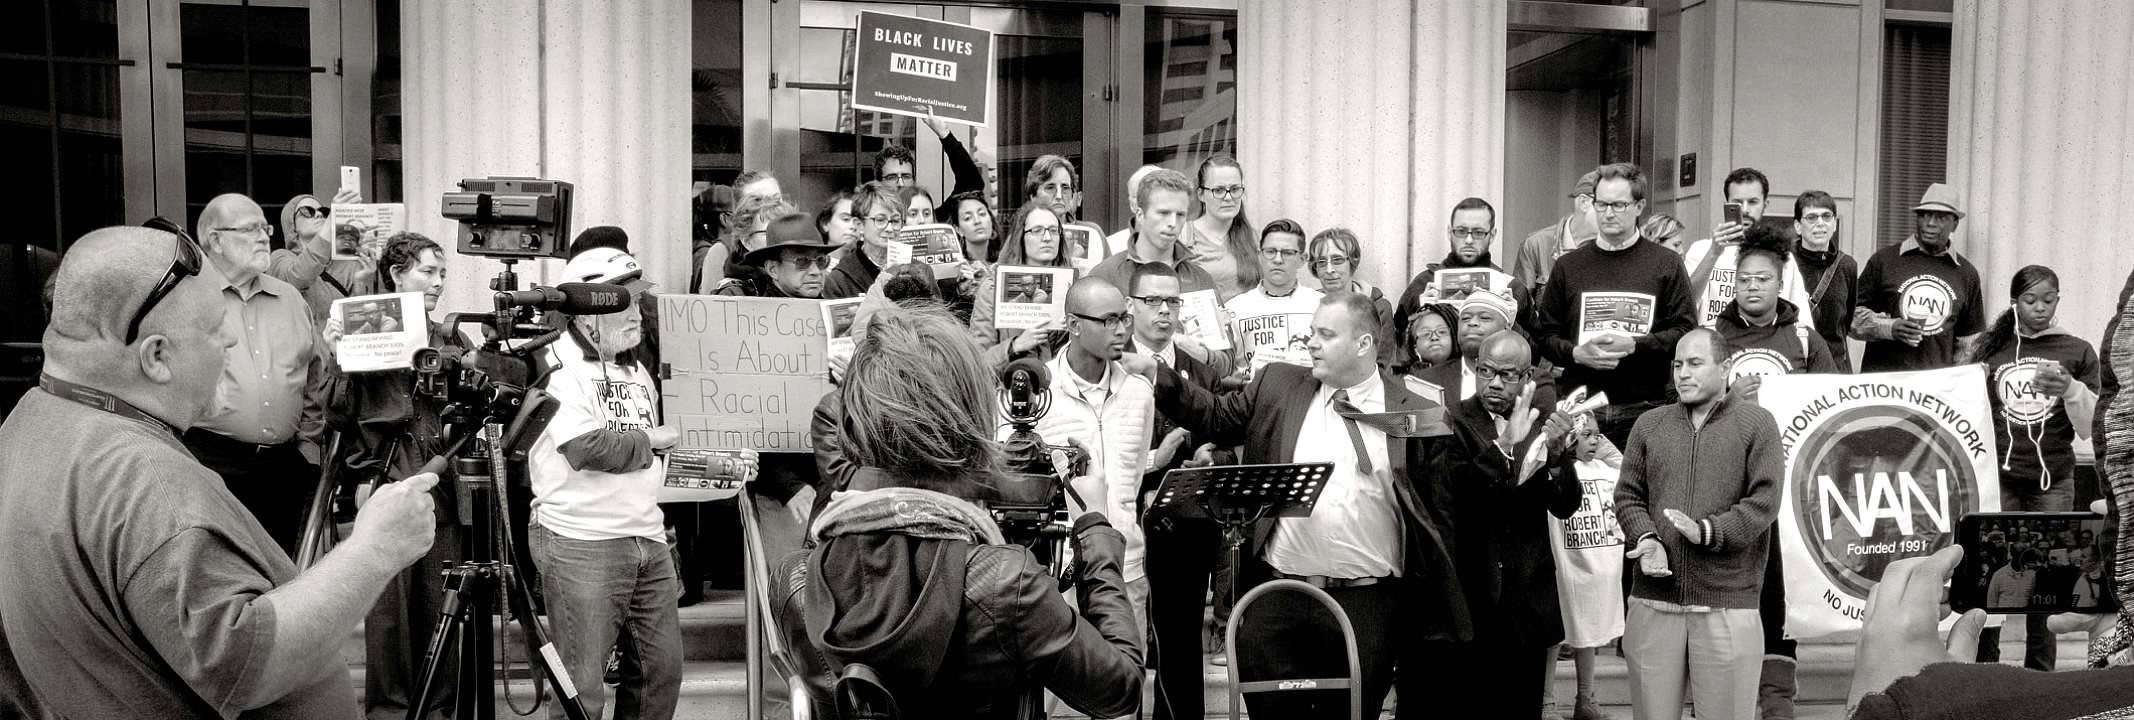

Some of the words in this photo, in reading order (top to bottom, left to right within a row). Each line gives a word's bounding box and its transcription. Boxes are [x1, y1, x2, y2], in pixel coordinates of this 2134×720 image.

[874, 28, 922, 48] BLACK
[933, 37, 974, 56] LIVES
[896, 57, 952, 78] MATTER
[874, 91, 968, 112] ShowingUpForRacialJustice.org
[590, 291, 619, 306] RØDE
[1908, 295, 1945, 316] NAN
[663, 298, 708, 333] IMO
[712, 299, 769, 337] This
[775, 303, 826, 337] Case
[1243, 315, 1286, 334] JUSTICE
[1254, 331, 1275, 346] FOR
[698, 339, 720, 371] Is
[736, 339, 812, 374] About
[595, 382, 632, 401] JUSIC
[700, 378, 788, 414] Racial
[1782, 395, 1837, 469] ATIONAL
[1838, 383, 1904, 404] ACTION
[1908, 390, 1988, 460] NETWORK
[1817, 468, 1951, 540] NAN
[1564, 514, 1601, 532] ROBERT
[1566, 530, 1606, 548] BRANCH
[1847, 542, 1896, 556] Founded
[1900, 540, 1927, 553] 1991
[1823, 588, 1842, 610] NO
